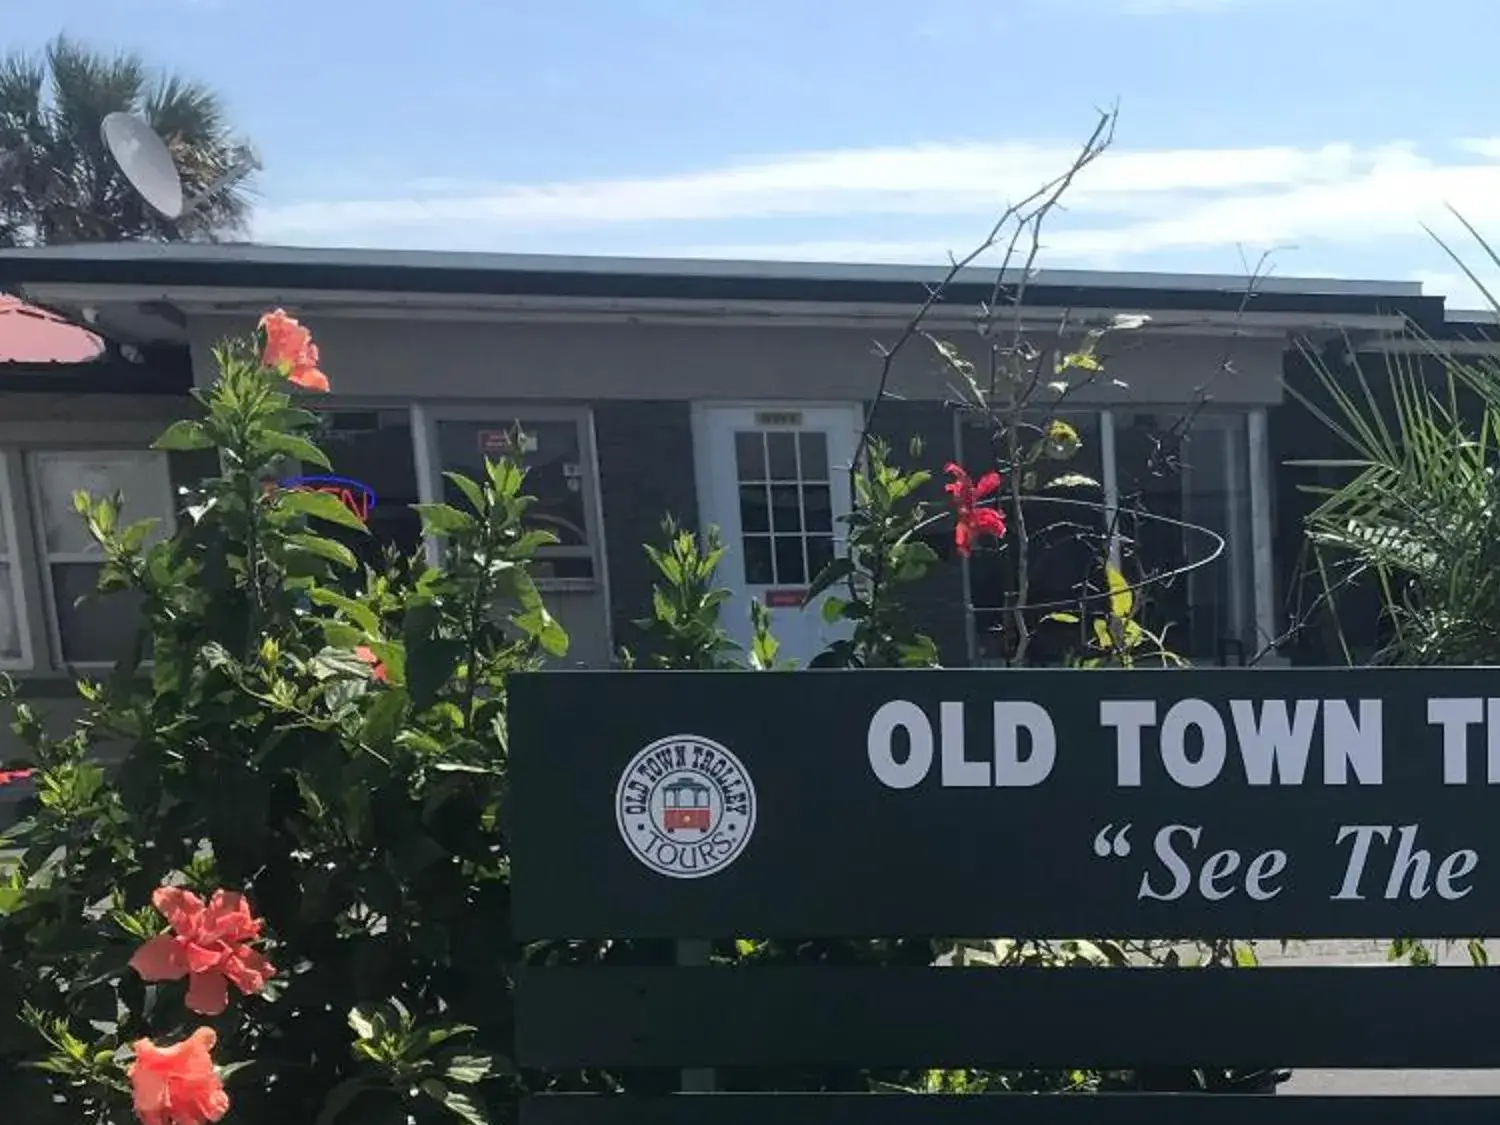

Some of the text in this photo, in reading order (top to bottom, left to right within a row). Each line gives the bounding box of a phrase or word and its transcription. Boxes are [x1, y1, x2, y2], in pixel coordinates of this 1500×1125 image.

[625, 744, 748, 816] OLD TOWN TROLLEY
[867, 699, 1057, 789] OLD
[1099, 697, 1383, 788] TOWN
[643, 830, 733, 869] TOURS
[1093, 822, 1288, 901] “See
[1329, 822, 1480, 900] The
